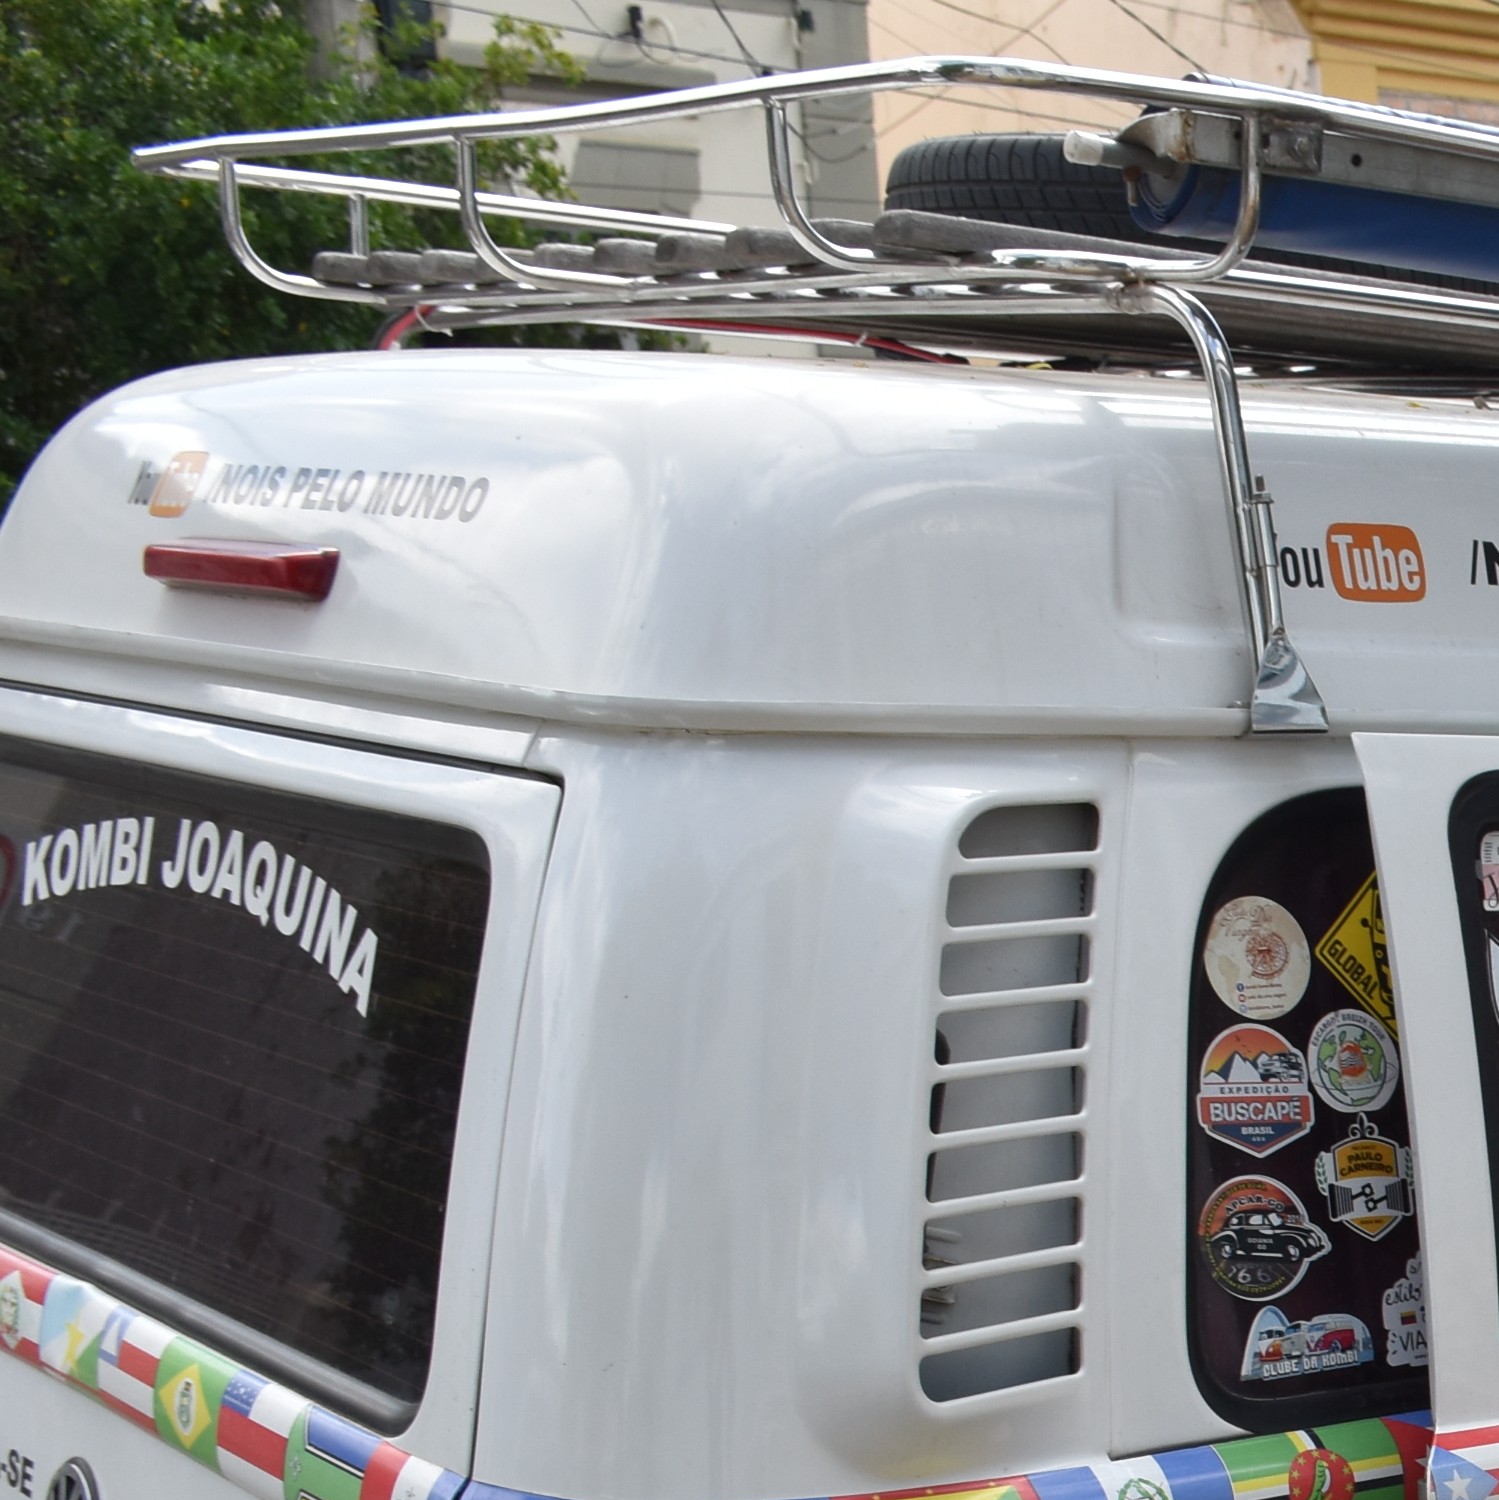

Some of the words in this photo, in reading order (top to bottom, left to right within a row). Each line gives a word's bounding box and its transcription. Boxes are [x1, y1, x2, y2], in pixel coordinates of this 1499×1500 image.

[283, 468, 364, 513] PELO
[363, 470, 489, 523] MUNDO
[1276, 545, 1323, 589] ou
[1331, 534, 1422, 592] Tube
[22, 816, 155, 906] KOMBI
[162, 818, 378, 1017] JOAQUINA
[1327, 938, 1381, 1000] GLOBAL
[1219, 1085, 1290, 1096] EXPEDIÇÃO
[1209, 1097, 1303, 1122] BUSCAPÉ
[1241, 1126, 1275, 1136] BRASIL
[1339, 1162, 1394, 1177] CARNEIRO
[1347, 1151, 1383, 1164] PAULO
[1262, 1360, 1298, 1378] CLUBE
[1322, 1350, 1358, 1366] KOMBI
